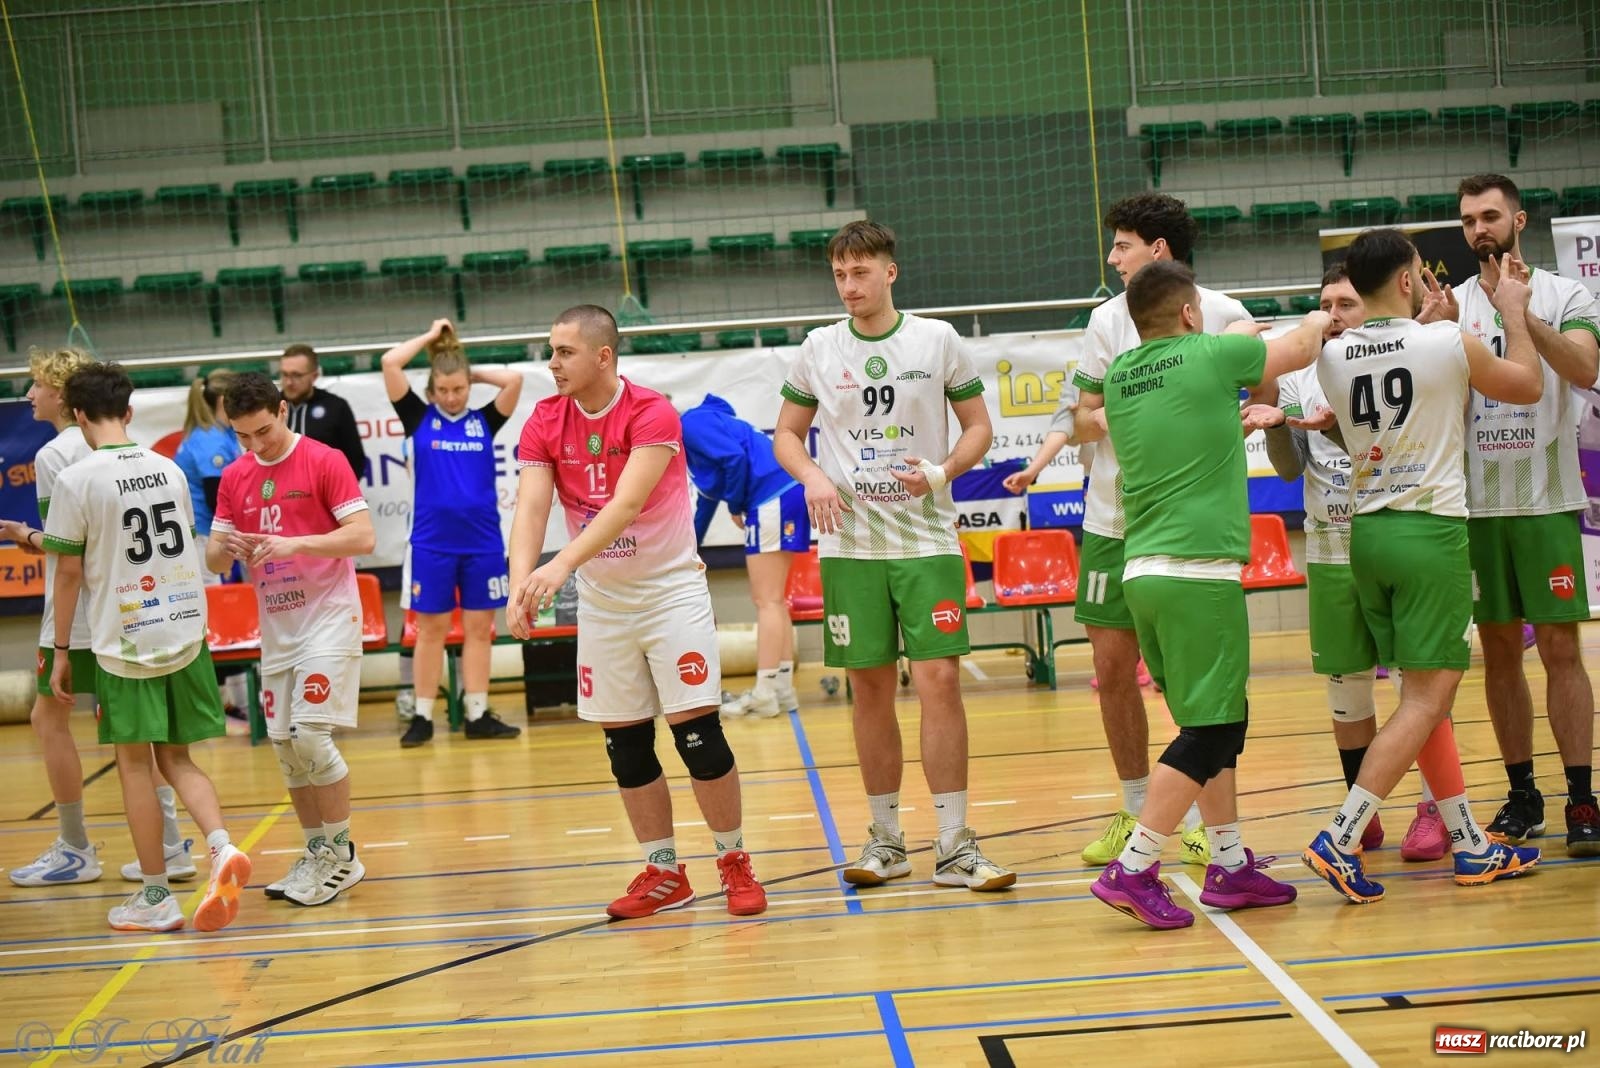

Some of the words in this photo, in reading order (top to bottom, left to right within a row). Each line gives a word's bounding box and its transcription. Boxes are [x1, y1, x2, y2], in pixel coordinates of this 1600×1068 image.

[1490, 335, 1502, 358] 1
[1129, 354, 1183, 381] SIATKARSKI
[1121, 375, 1165, 400] RACIBÓRZ
[1350, 367, 1414, 433] 49
[862, 384, 895, 417] 99
[848, 424, 915, 441] VISON
[1476, 427, 1536, 444] PIVEXIN
[1478, 440, 1536, 453] TECHNOLOGY
[1317, 458, 1352, 470] VIS
[115, 471, 169, 497] JAROCKI
[857, 493, 911, 503] TECHNOLOGY
[260, 504, 284, 533] 42
[122, 500, 185, 565] 35
[116, 582, 139, 594] radio
[265, 589, 305, 606] PIVEXIN
[1086, 570, 1109, 604] 11
[827, 613, 851, 647] 99
[263, 689, 275, 719] 2
